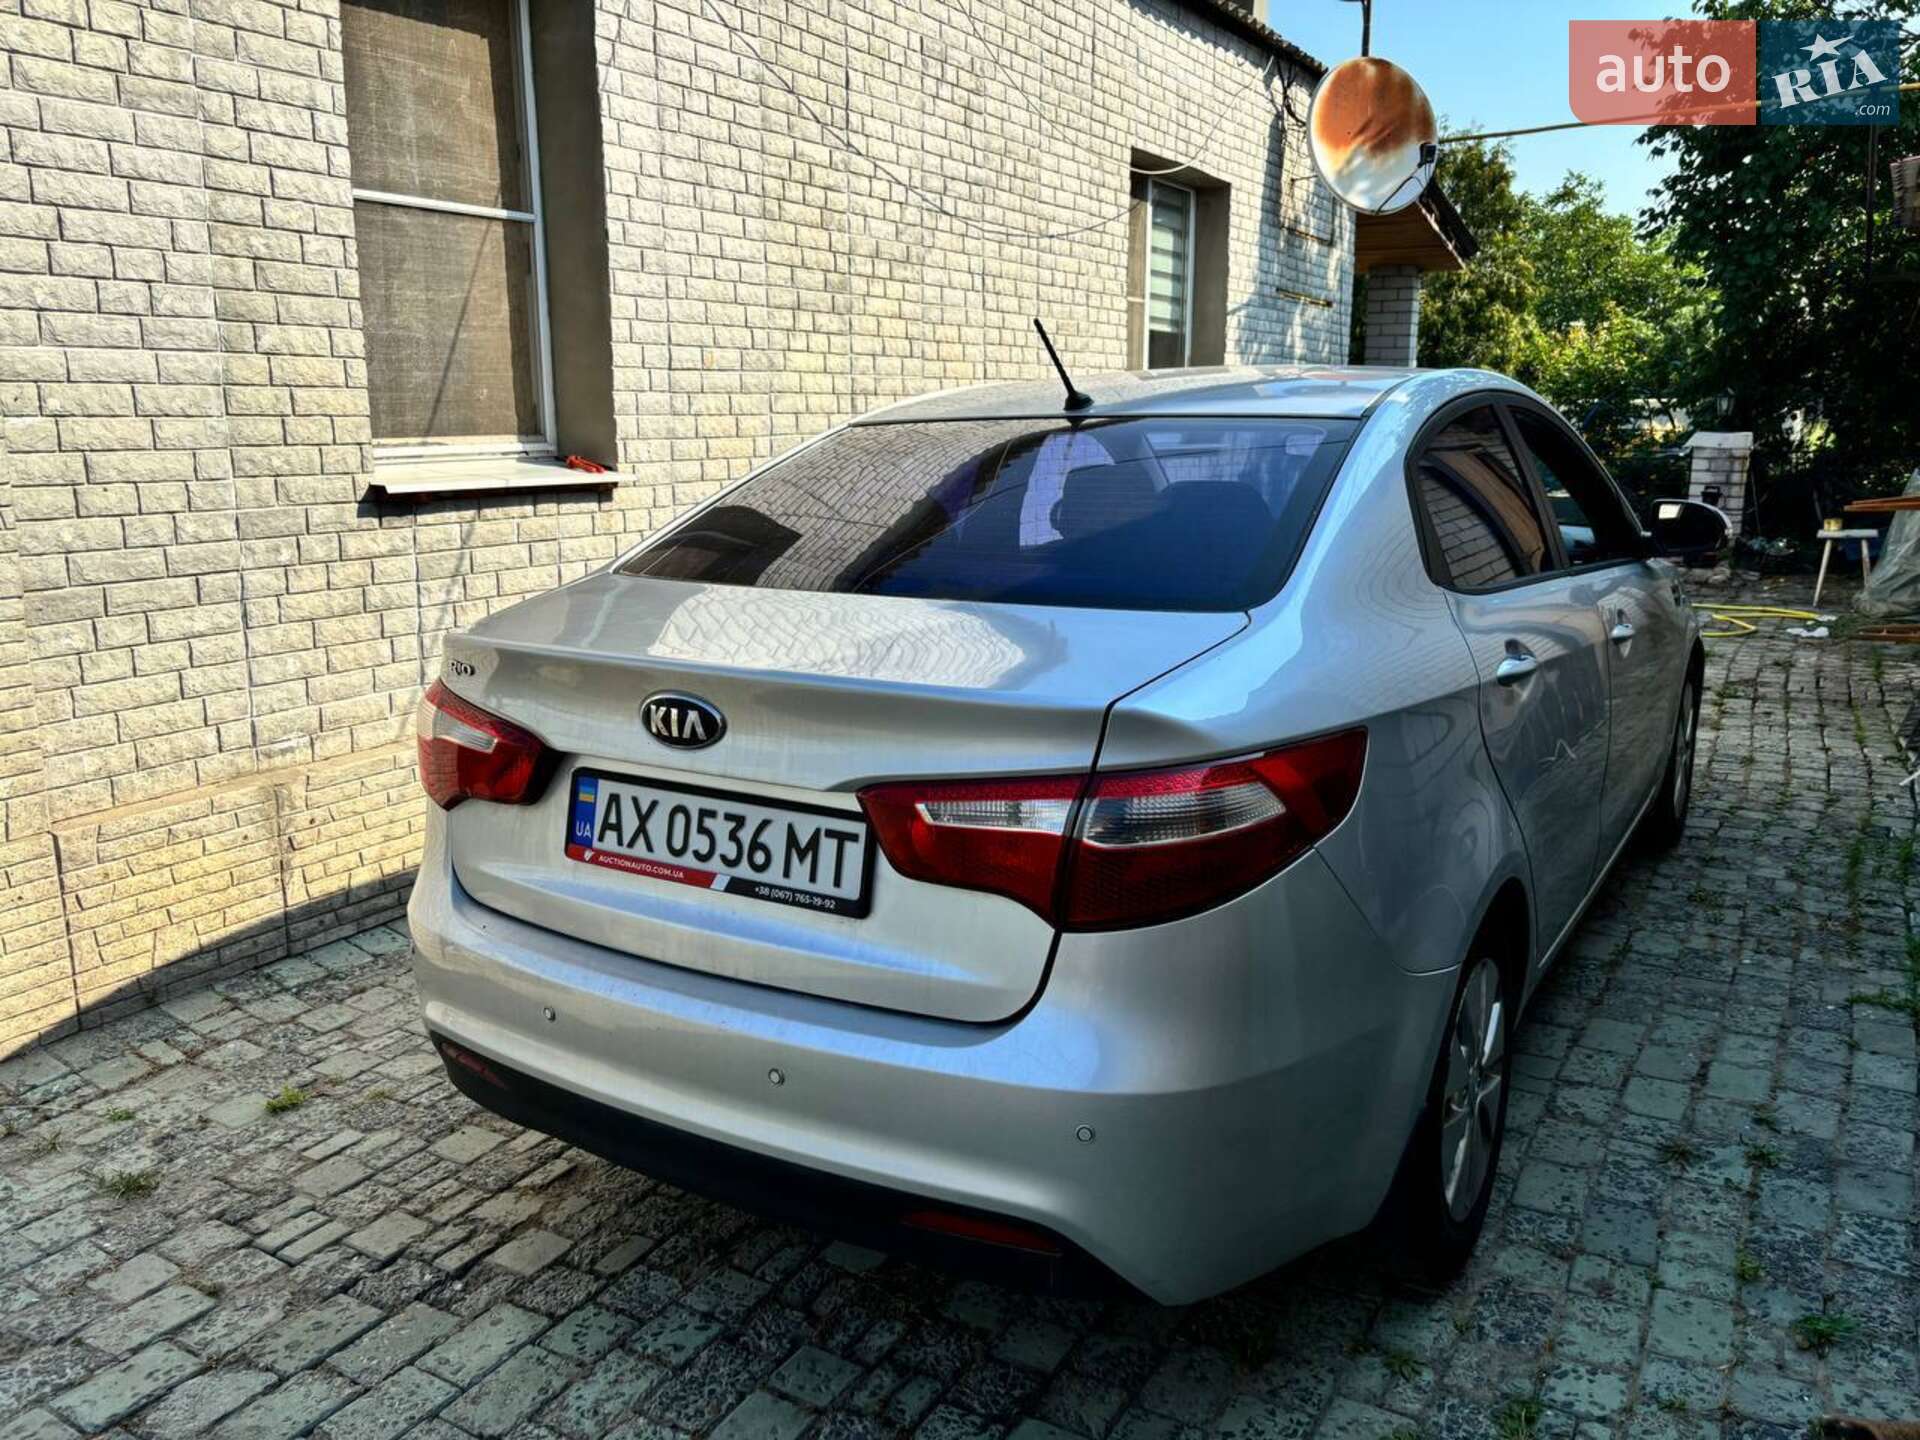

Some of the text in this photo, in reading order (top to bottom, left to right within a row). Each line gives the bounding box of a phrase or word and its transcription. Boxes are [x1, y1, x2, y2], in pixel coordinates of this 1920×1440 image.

[650, 703, 707, 741] KIA
[575, 820, 592, 840] UA
[598, 854, 684, 880] AUCTIONAUTO.COM.UA
[754, 886, 837, 910] +38 (067) 765-19-92
